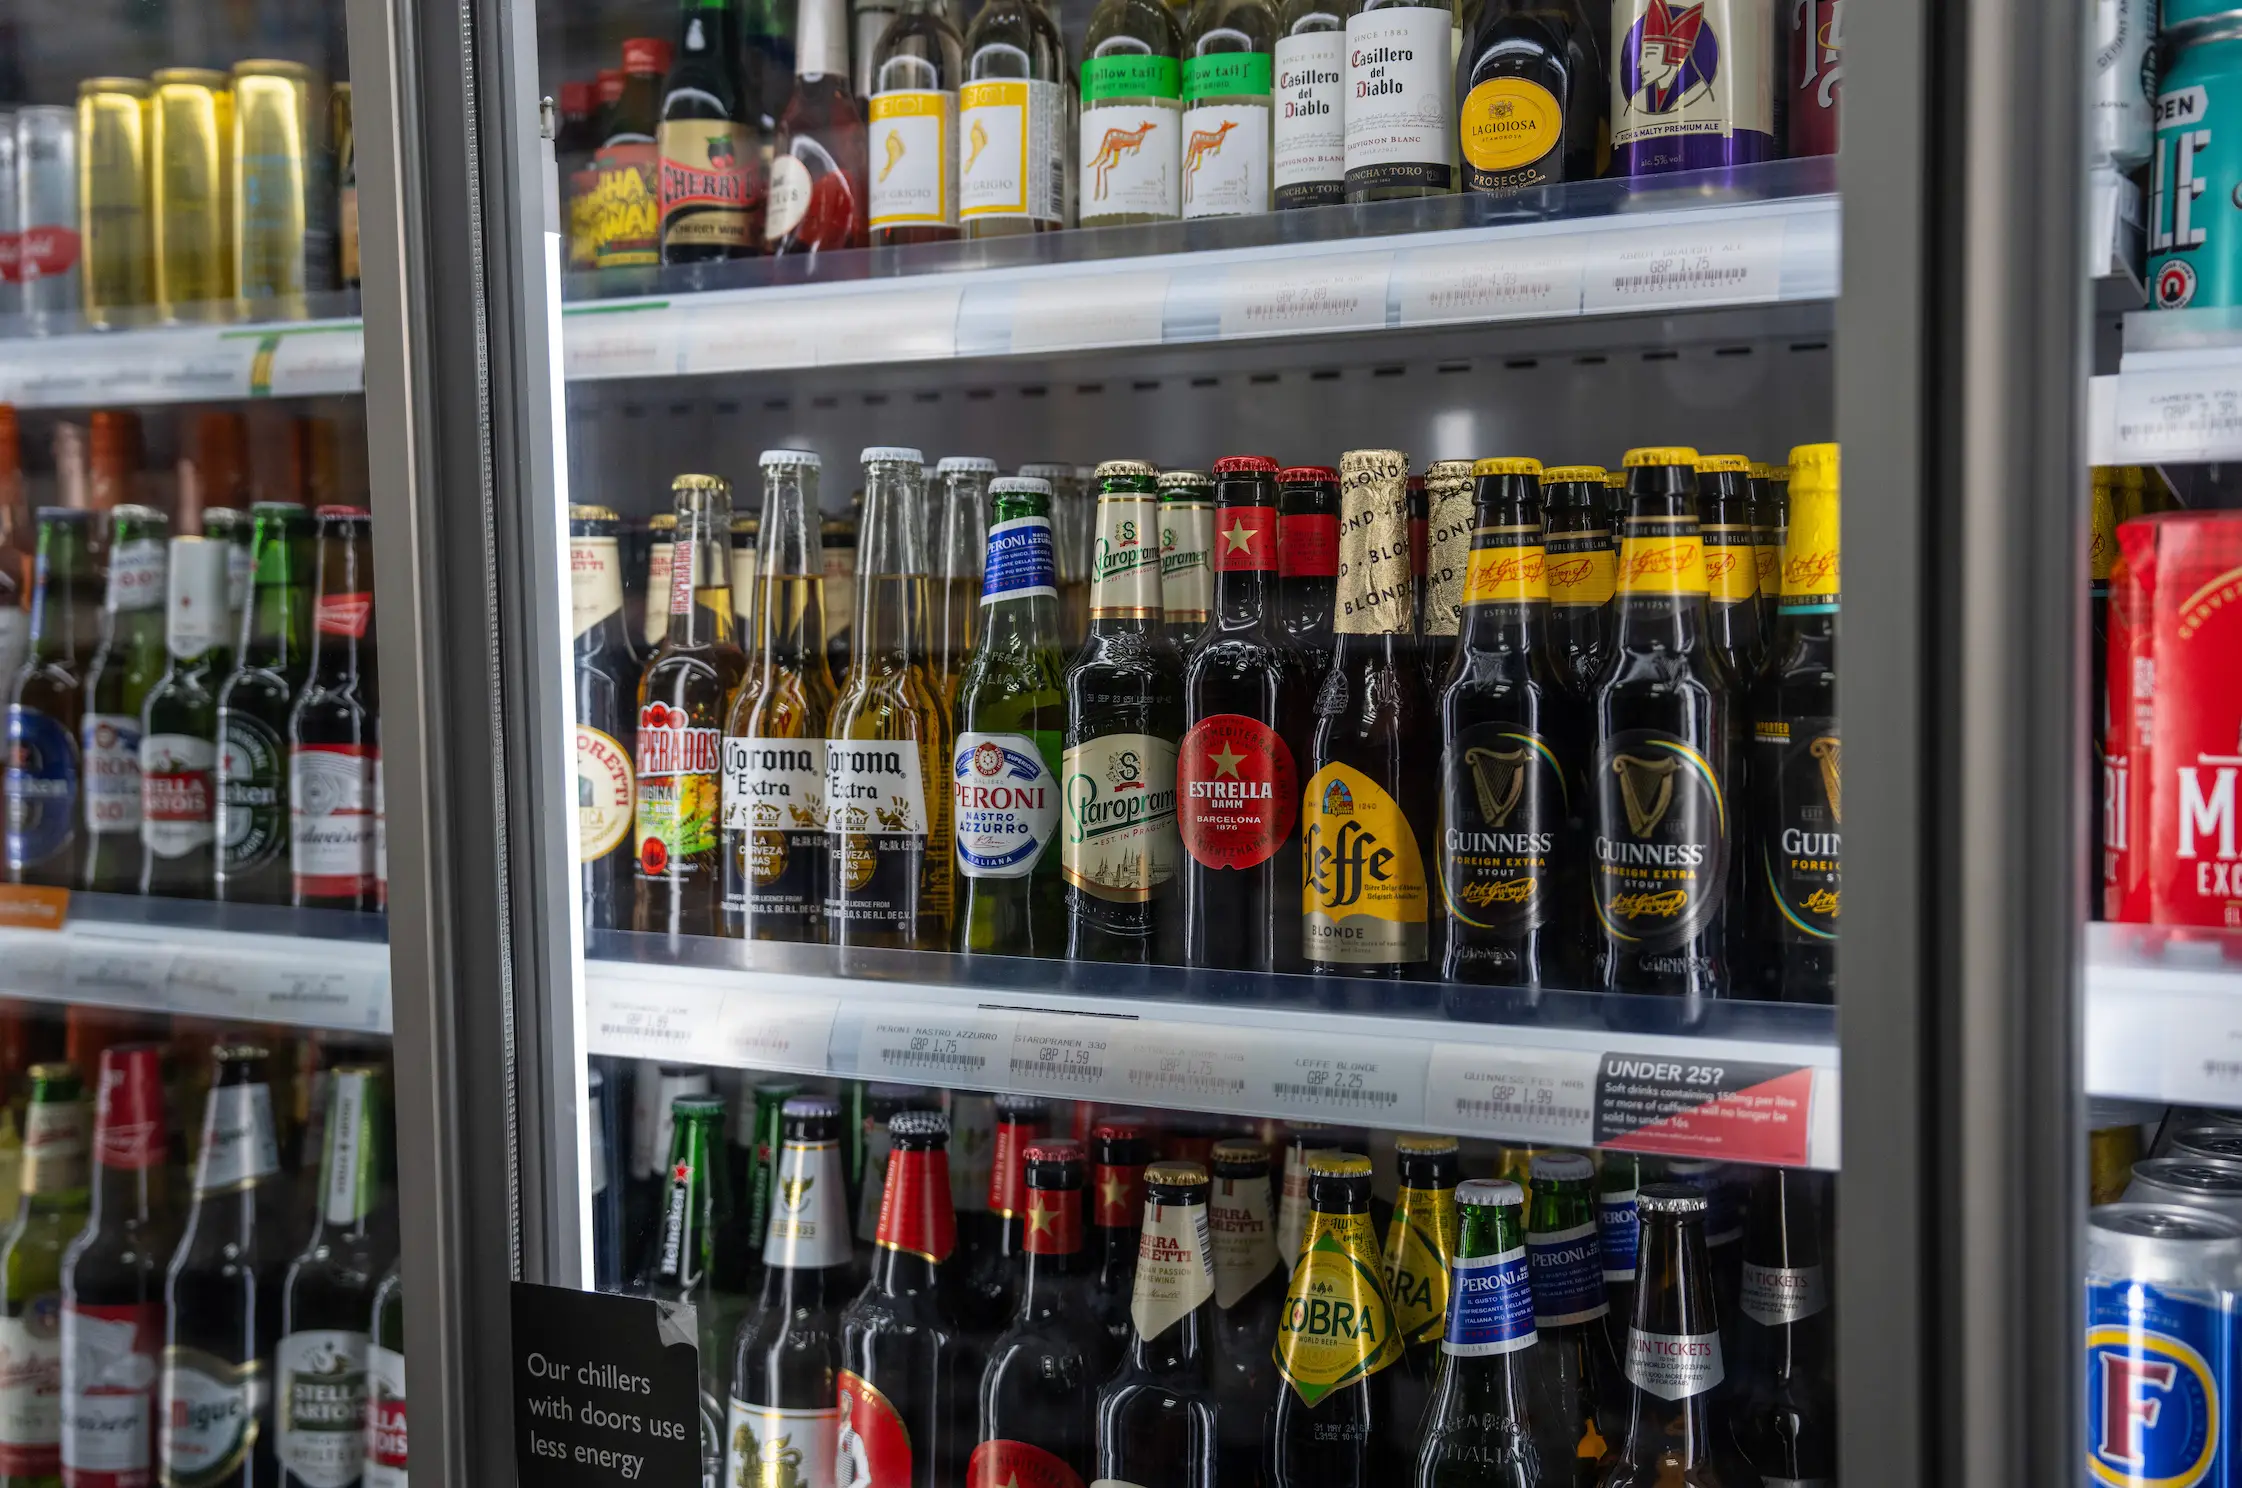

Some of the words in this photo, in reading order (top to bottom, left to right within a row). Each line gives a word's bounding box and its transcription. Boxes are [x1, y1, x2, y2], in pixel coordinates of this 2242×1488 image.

[1351, 47, 1413, 68] Casillero
[1280, 69, 1340, 89] Casillero
[1370, 66, 1385, 79] del
[1298, 87, 1312, 99] del
[1356, 78, 1403, 99] Diablo
[1285, 100, 1330, 119] Diablo
[1621, 131, 1633, 142] RICH
[1639, 127, 1662, 136] MALTY
[1664, 123, 1702, 133] PREMIUM
[1654, 155, 1668, 165] 5%
[1669, 155, 1683, 163] vol.
[1389, 166, 1422, 177] TORO
[1474, 169, 1537, 187] PROSECCO
[664, 166, 741, 204] CHERRY
[1650, 259, 1672, 273] GBP
[1681, 257, 1710, 271] 1.75
[987, 534, 1026, 555] PERONI
[724, 740, 814, 776] Corona
[825, 742, 902, 779] Corona
[1007, 753, 1037, 774] SUPERIORE
[733, 774, 791, 797] Extra
[828, 776, 878, 799] Extra
[1188, 781, 1273, 799] ESTRELLA
[955, 781, 1045, 810] PERONI
[1211, 799, 1243, 809] DAMM
[966, 811, 1015, 822] NASTRO
[1197, 815, 1262, 824] BARCELONA
[959, 821, 1029, 834] AZZURRO
[1101, 836, 1117, 846] EST.
[1133, 822, 1166, 837] PRAGUE
[752, 836, 767, 845] LA
[1445, 827, 1551, 853] GUINNESS
[738, 845, 783, 856] CRVEZA
[832, 849, 871, 860] CEVEZA
[1595, 835, 1706, 866] GUINNESS
[967, 853, 1013, 867] ITALIANA
[1303, 819, 1395, 908] Leffe
[1451, 855, 1501, 867] FOREIGN
[1506, 857, 1546, 867] EXTRA
[1477, 868, 1516, 876] STOUT
[1600, 865, 1648, 878] FOREIGN
[1653, 869, 1697, 880] EXTRA
[1624, 879, 1663, 889] STOUT
[873, 900, 890, 908] FROM
[863, 911, 872, 919] DE
[873, 911, 886, 919] R.L.
[887, 911, 897, 919] DE
[898, 911, 911, 919] C.V.
[1312, 924, 1364, 939] BLONDE
[877, 1025, 910, 1034] PERONI
[916, 1028, 951, 1037] NASTRO
[956, 1031, 998, 1041] AZZURRO
[911, 1037, 929, 1051] GBP
[934, 1039, 957, 1053] 1.75
[1015, 1035, 1082, 1048] STAROPRAMEN
[1087, 1041, 1107, 1050] 330
[1040, 1047, 1059, 1061] GBP
[1064, 1049, 1089, 1064] 1.59
[1160, 1058, 1181, 1072] GBP
[1187, 1060, 1212, 1075] 1.75
[1294, 1058, 1331, 1068] LEFFE
[1336, 1061, 1380, 1073] BLONDE
[1606, 1060, 1682, 1082] UNDER
[1686, 1065, 1724, 1085] 25?
[1307, 1070, 1329, 1085] GBP
[1334, 1072, 1363, 1088] 2.25
[1464, 1071, 1525, 1084] GUINNESS
[1492, 1085, 1516, 1101] GBP
[1523, 1088, 1553, 1105] 1.99
[1604, 1082, 1626, 1093] Soft
[1626, 1084, 1659, 1097] drinks
[1660, 1088, 1715, 1103] containing
[1602, 1111, 1625, 1122] sold
[1625, 1113, 1638, 1123] to
[1638, 1115, 1668, 1126] under
[1671, 1116, 1689, 1128] 16s
[1603, 1099, 1614, 1107] or
[1615, 1100, 1644, 1110] more
[1644, 1100, 1656, 1111] of
[1657, 1101, 1699, 1115] caffeine
[1700, 1104, 1720, 1116] will
[1720, 1107, 1735, 1119] no
[1736, 1107, 1771, 1123] longer
[1772, 1110, 1788, 1122] be
[1532, 1246, 1585, 1267] PERONI
[1158, 1267, 1192, 1277] PASSION
[1754, 1272, 1809, 1288] TICKETS
[1459, 1270, 1516, 1292] PERONI
[1474, 1296, 1498, 1305] GUSTO
[1505, 1302, 1522, 1310] DELLA
[1281, 1296, 1376, 1343] COBRA
[1464, 1316, 1493, 1325] ITALIANA
[1298, 1335, 1319, 1344] WORLD
[1320, 1339, 1338, 1347] BEER
[1654, 1342, 1711, 1356] TICKETS
[527, 1352, 570, 1381] Our
[577, 1361, 651, 1395] chillers
[2098, 1350, 2177, 1468] F
[528, 1396, 573, 1422] with
[580, 1400, 642, 1434] doors
[650, 1417, 686, 1441] use
[530, 1429, 568, 1460] less
[574, 1444, 644, 1480] energy
